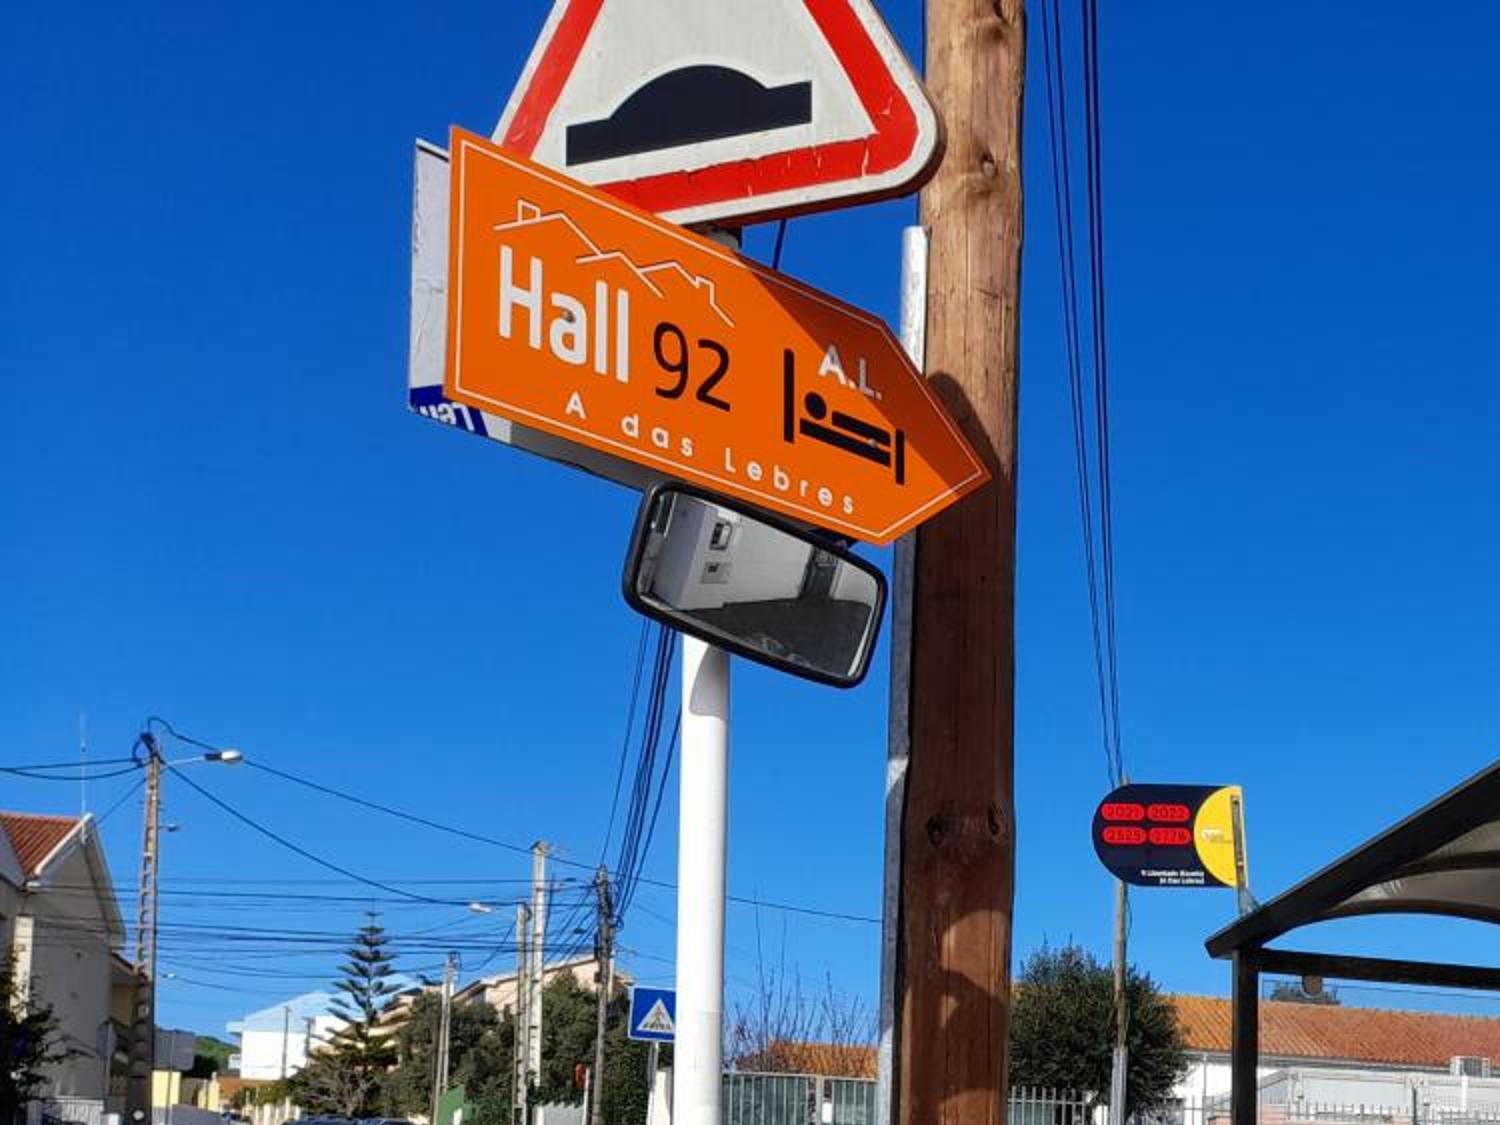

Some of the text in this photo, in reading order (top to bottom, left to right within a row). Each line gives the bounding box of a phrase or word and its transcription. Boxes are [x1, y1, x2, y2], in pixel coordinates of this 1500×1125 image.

[497, 245, 732, 412] Hall 92
[818, 343, 883, 402] A.L.
[565, 391, 855, 516] A das Lebres
